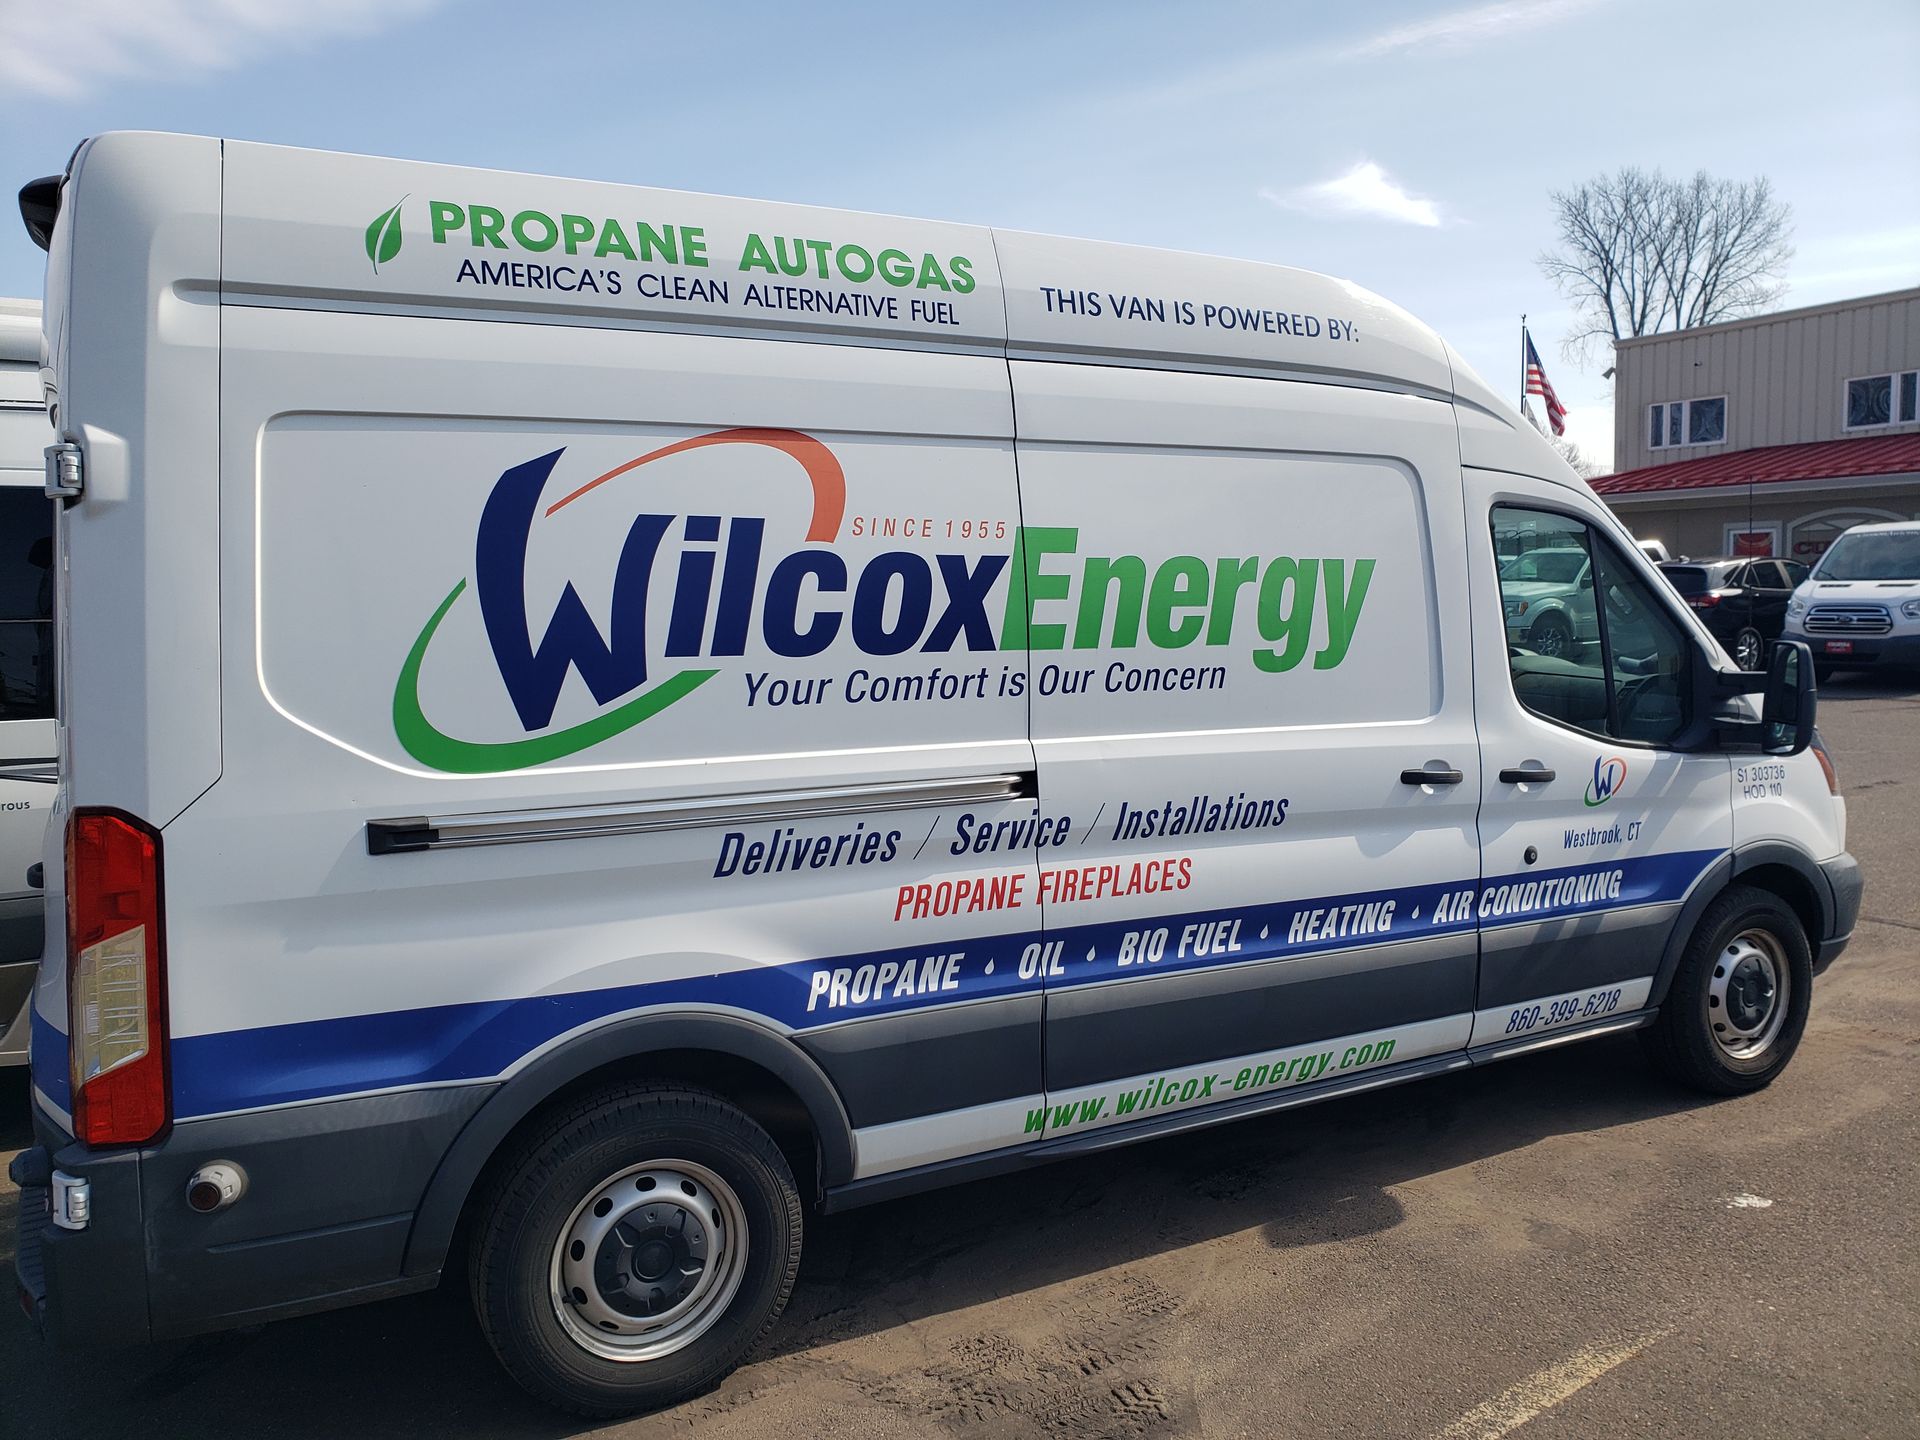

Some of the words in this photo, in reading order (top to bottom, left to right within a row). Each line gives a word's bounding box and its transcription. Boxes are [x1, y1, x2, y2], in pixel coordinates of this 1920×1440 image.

[429, 200, 710, 267] PROPANE
[738, 232, 976, 294] AUTOGAS
[456, 258, 622, 295] AMERICA'S
[637, 273, 729, 304] CLEAN
[743, 283, 899, 320] ALTERNATIVE
[911, 300, 960, 325] FUEL
[1039, 286, 1102, 317] THIS
[1108, 294, 1166, 323] VAN
[1174, 300, 1196, 325] IS
[1203, 304, 1321, 338] POWERED
[1327, 318, 1360, 343] BY:
[852, 516, 934, 539] SINCE
[945, 519, 1007, 541] 1955
[744, 671, 833, 707] Your
[845, 667, 986, 704] Comfort
[998, 665, 1027, 697] is
[1038, 664, 1095, 697] Our
[1104, 661, 1227, 693] Concern
[1743, 785, 1767, 800] HOD
[1769, 783, 1783, 797] 110
[1751, 764, 1786, 781] 303736
[713, 823, 900, 878] Deliveries
[950, 810, 1072, 856] Service
[1111, 792, 1290, 842] Installations
[1563, 821, 1623, 849] Westbrook,
[1627, 821, 1642, 841] CT
[894, 873, 1026, 922] PROPANE
[1035, 857, 1193, 906] FIREPLACES
[806, 952, 966, 1012] PROPANE
[1017, 939, 1065, 980] OIL
[1116, 926, 1171, 967] BIO
[1177, 918, 1242, 959] FUEL
[1287, 900, 1395, 944] HEATING
[1431, 889, 1474, 924] AIR
[1476, 868, 1624, 921] CONDITIONING
[1505, 988, 1622, 1034] 860-399-6218
[1023, 1036, 1398, 1135] www.wilcox-energy.com
